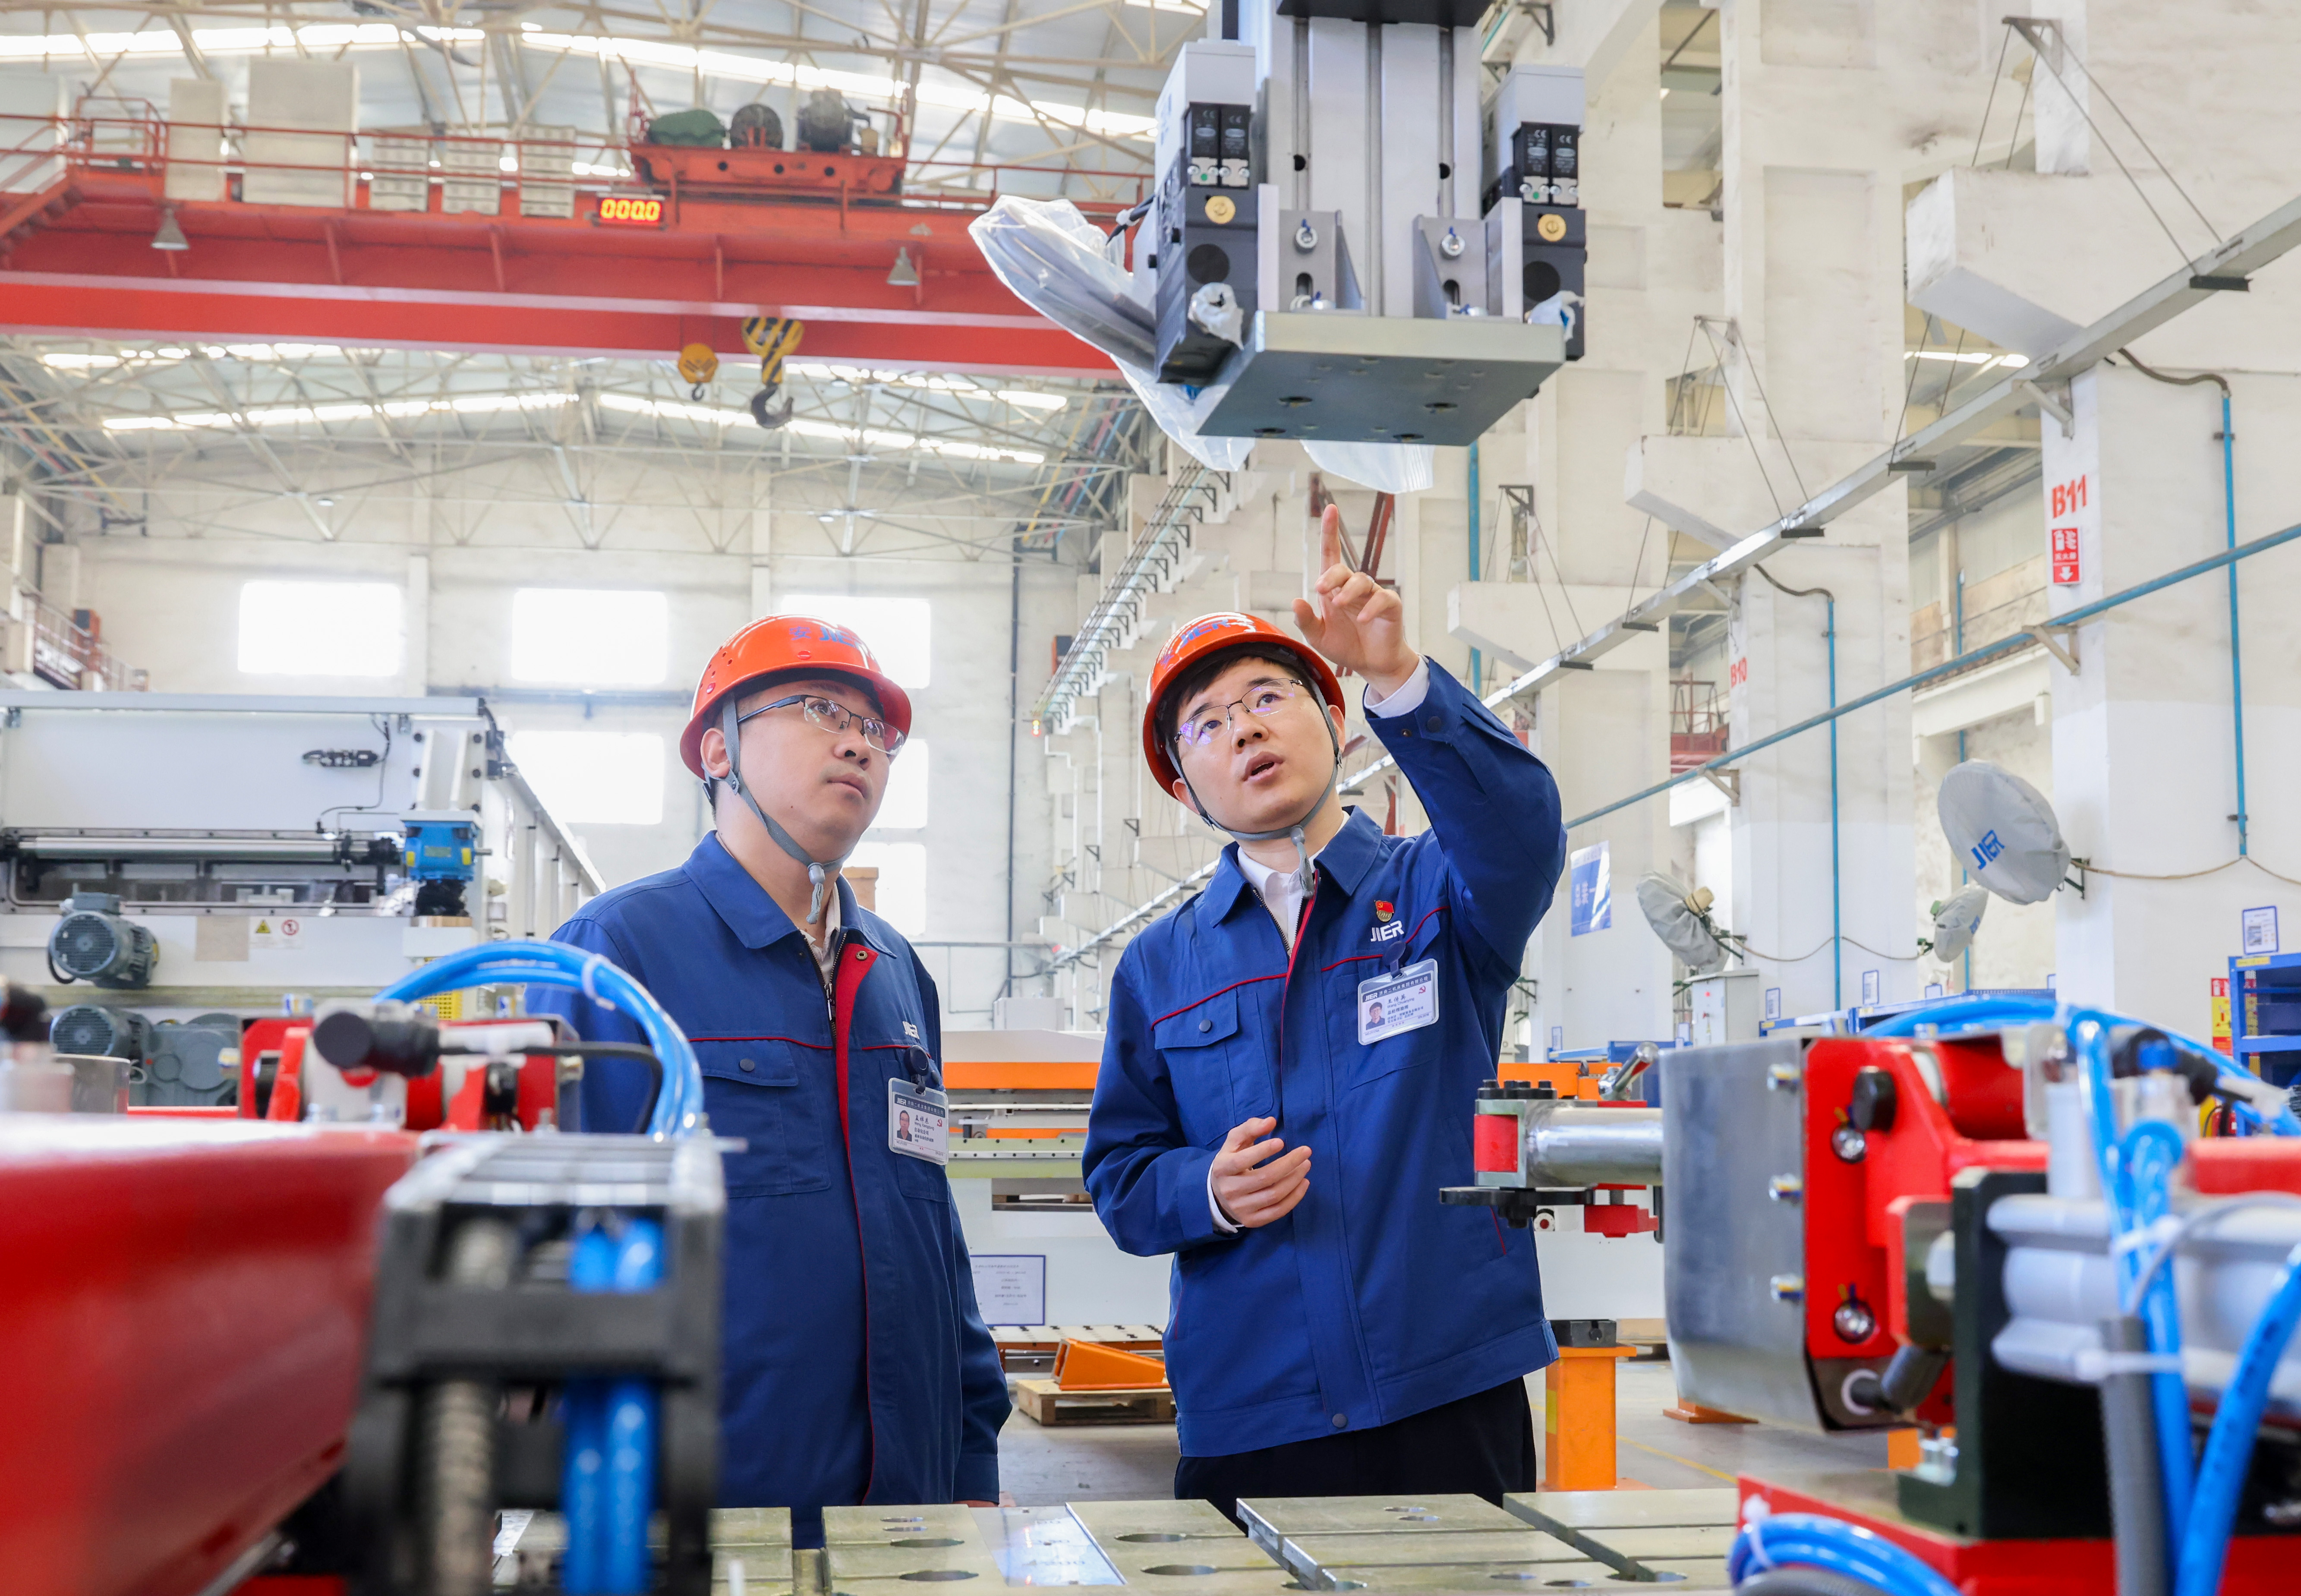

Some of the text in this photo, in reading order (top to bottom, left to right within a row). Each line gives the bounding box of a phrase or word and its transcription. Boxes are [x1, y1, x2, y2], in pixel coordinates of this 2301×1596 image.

[2052, 474, 2087, 518] B11
[789, 626, 812, 640] 安
[1971, 830, 2005, 870] JIER
[1371, 920, 1404, 942] JIER
[1365, 992, 1378, 1001] JIER
[902, 1021, 920, 1039] JIER
[897, 1097, 907, 1105] JIER
